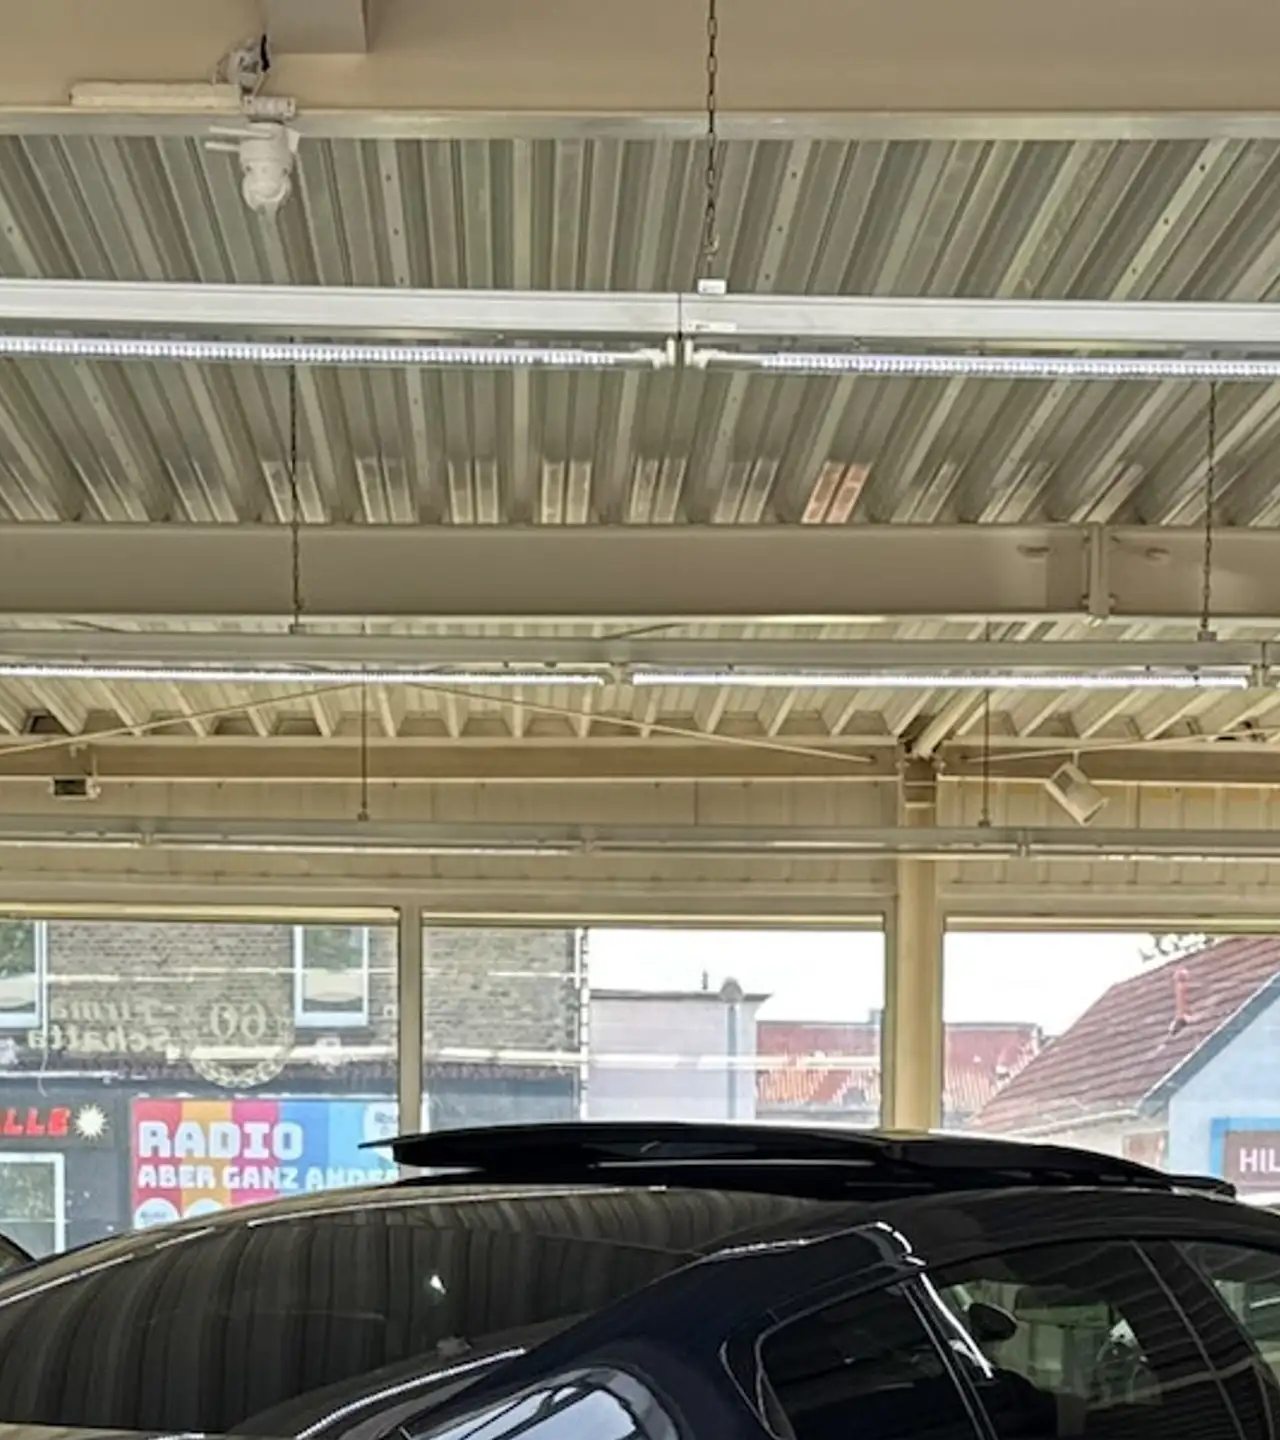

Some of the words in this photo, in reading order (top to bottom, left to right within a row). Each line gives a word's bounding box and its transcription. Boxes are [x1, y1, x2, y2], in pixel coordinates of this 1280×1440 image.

[138, 1120, 303, 1160] RADIO
[137, 1164, 217, 1189] ABER
[222, 1165, 299, 1190] GANZ
